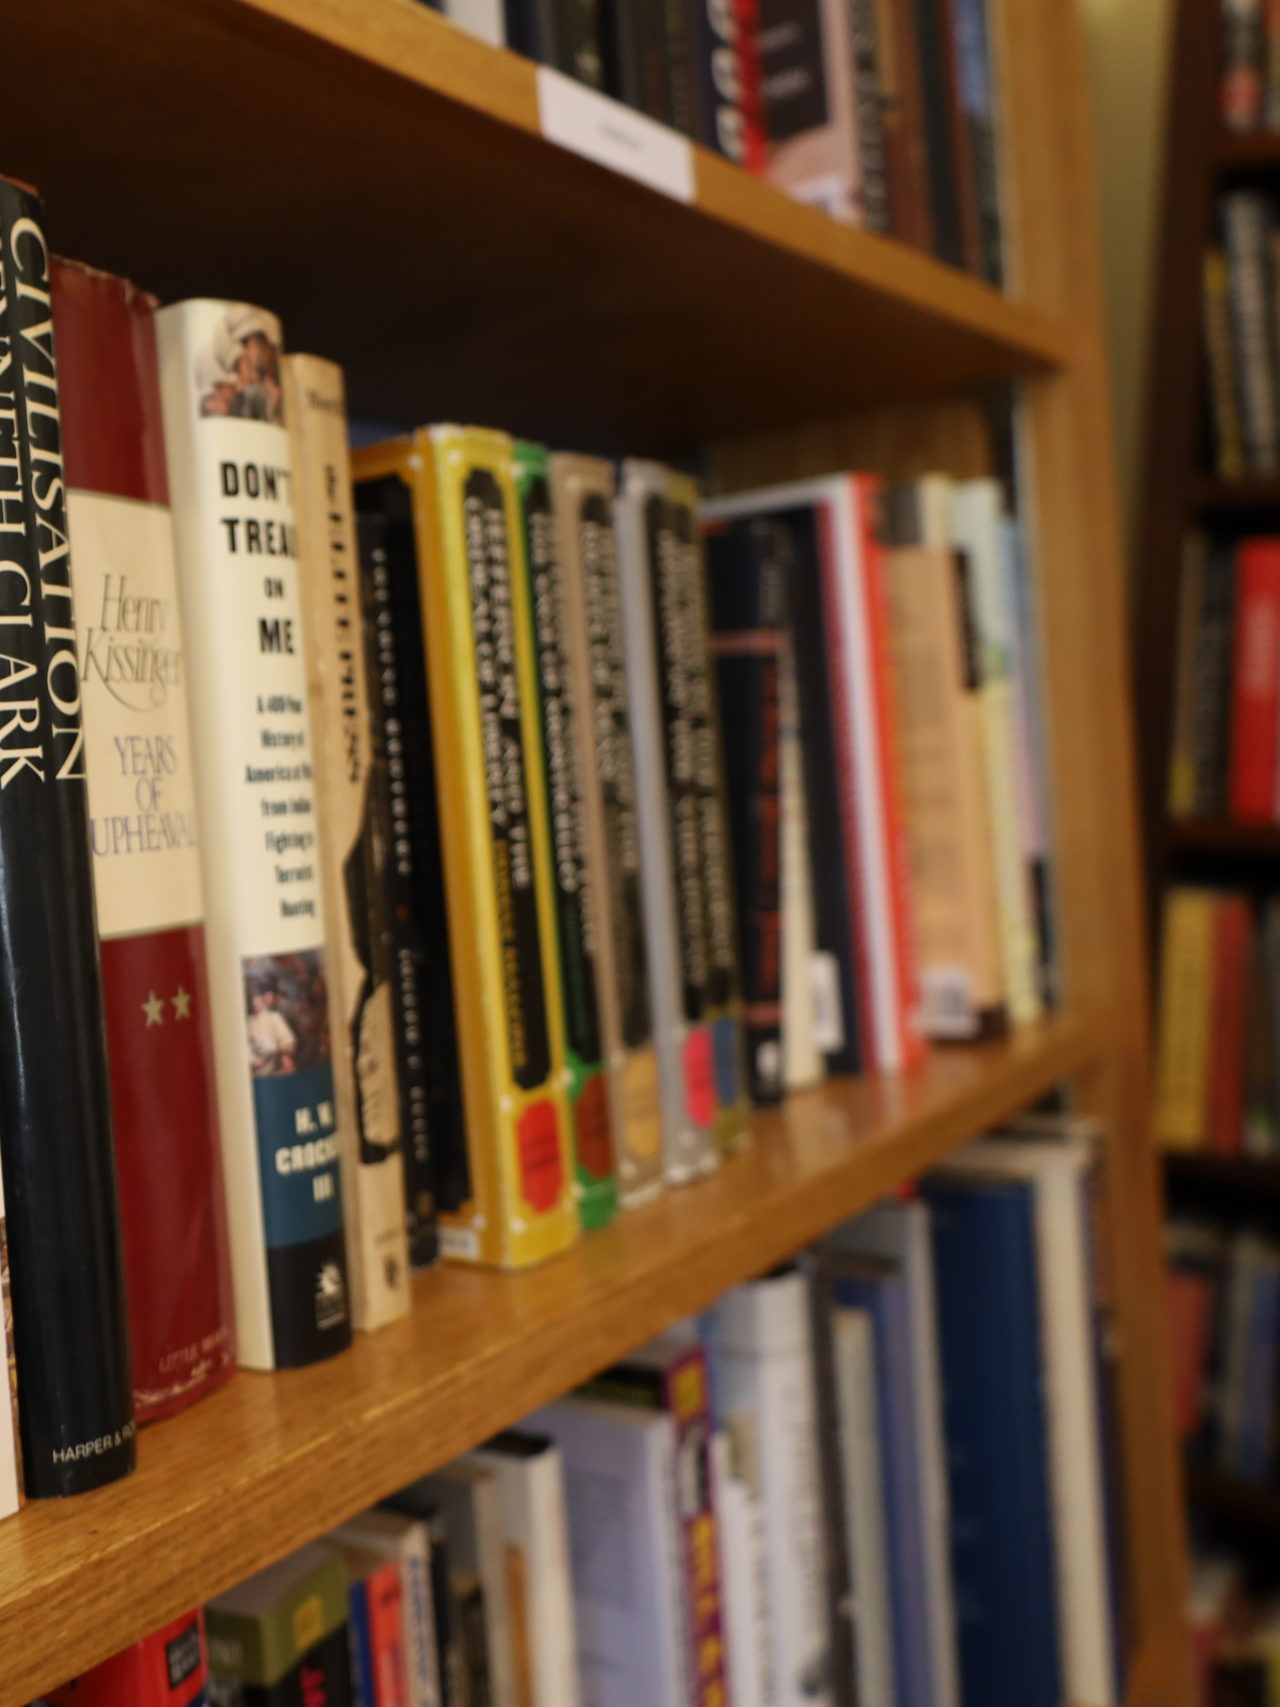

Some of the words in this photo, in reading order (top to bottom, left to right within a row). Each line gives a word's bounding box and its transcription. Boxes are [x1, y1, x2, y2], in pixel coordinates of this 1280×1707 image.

[9, 216, 89, 783] CIVILISATION
[221, 517, 300, 561] TREA
[264, 576, 285, 599] ON
[258, 617, 295, 656] ME
[113, 734, 178, 777] YEARS
[134, 776, 163, 813] OF
[52, 1434, 113, 1464] HARPER
